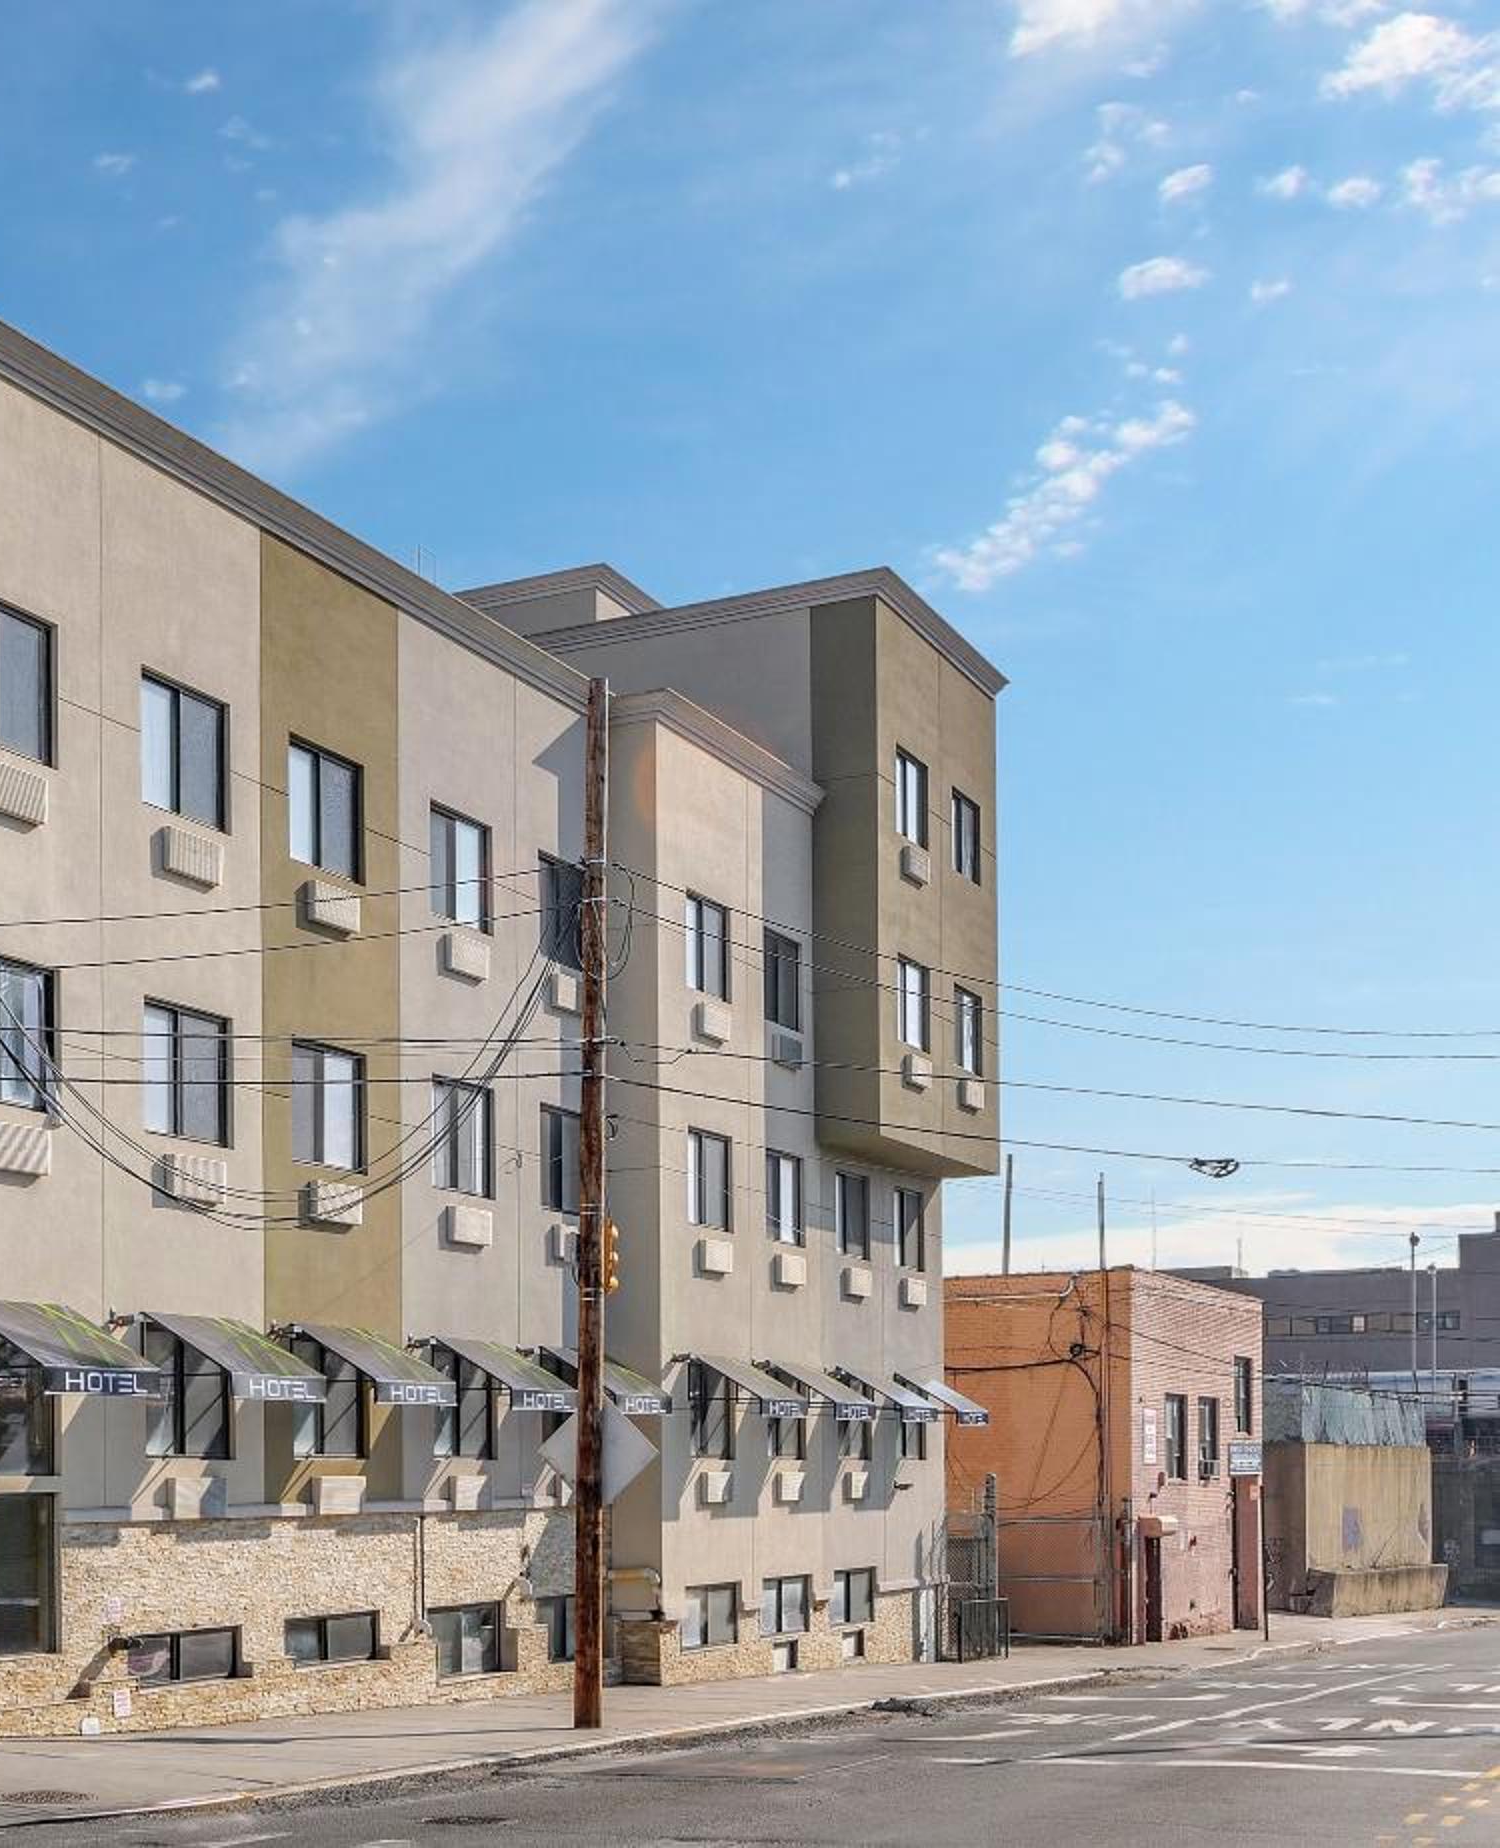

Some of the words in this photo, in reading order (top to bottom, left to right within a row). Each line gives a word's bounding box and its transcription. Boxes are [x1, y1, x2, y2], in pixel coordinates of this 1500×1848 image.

[65, 1371, 149, 1393] HOTEL
[249, 1378, 317, 1399] HOTEL
[391, 1385, 448, 1402] HOTEL
[523, 1392, 572, 1409] HOTEL
[625, 1397, 667, 1413] HOTEL
[769, 1401, 803, 1416] HOTEL
[842, 1405, 873, 1419] HOTEL
